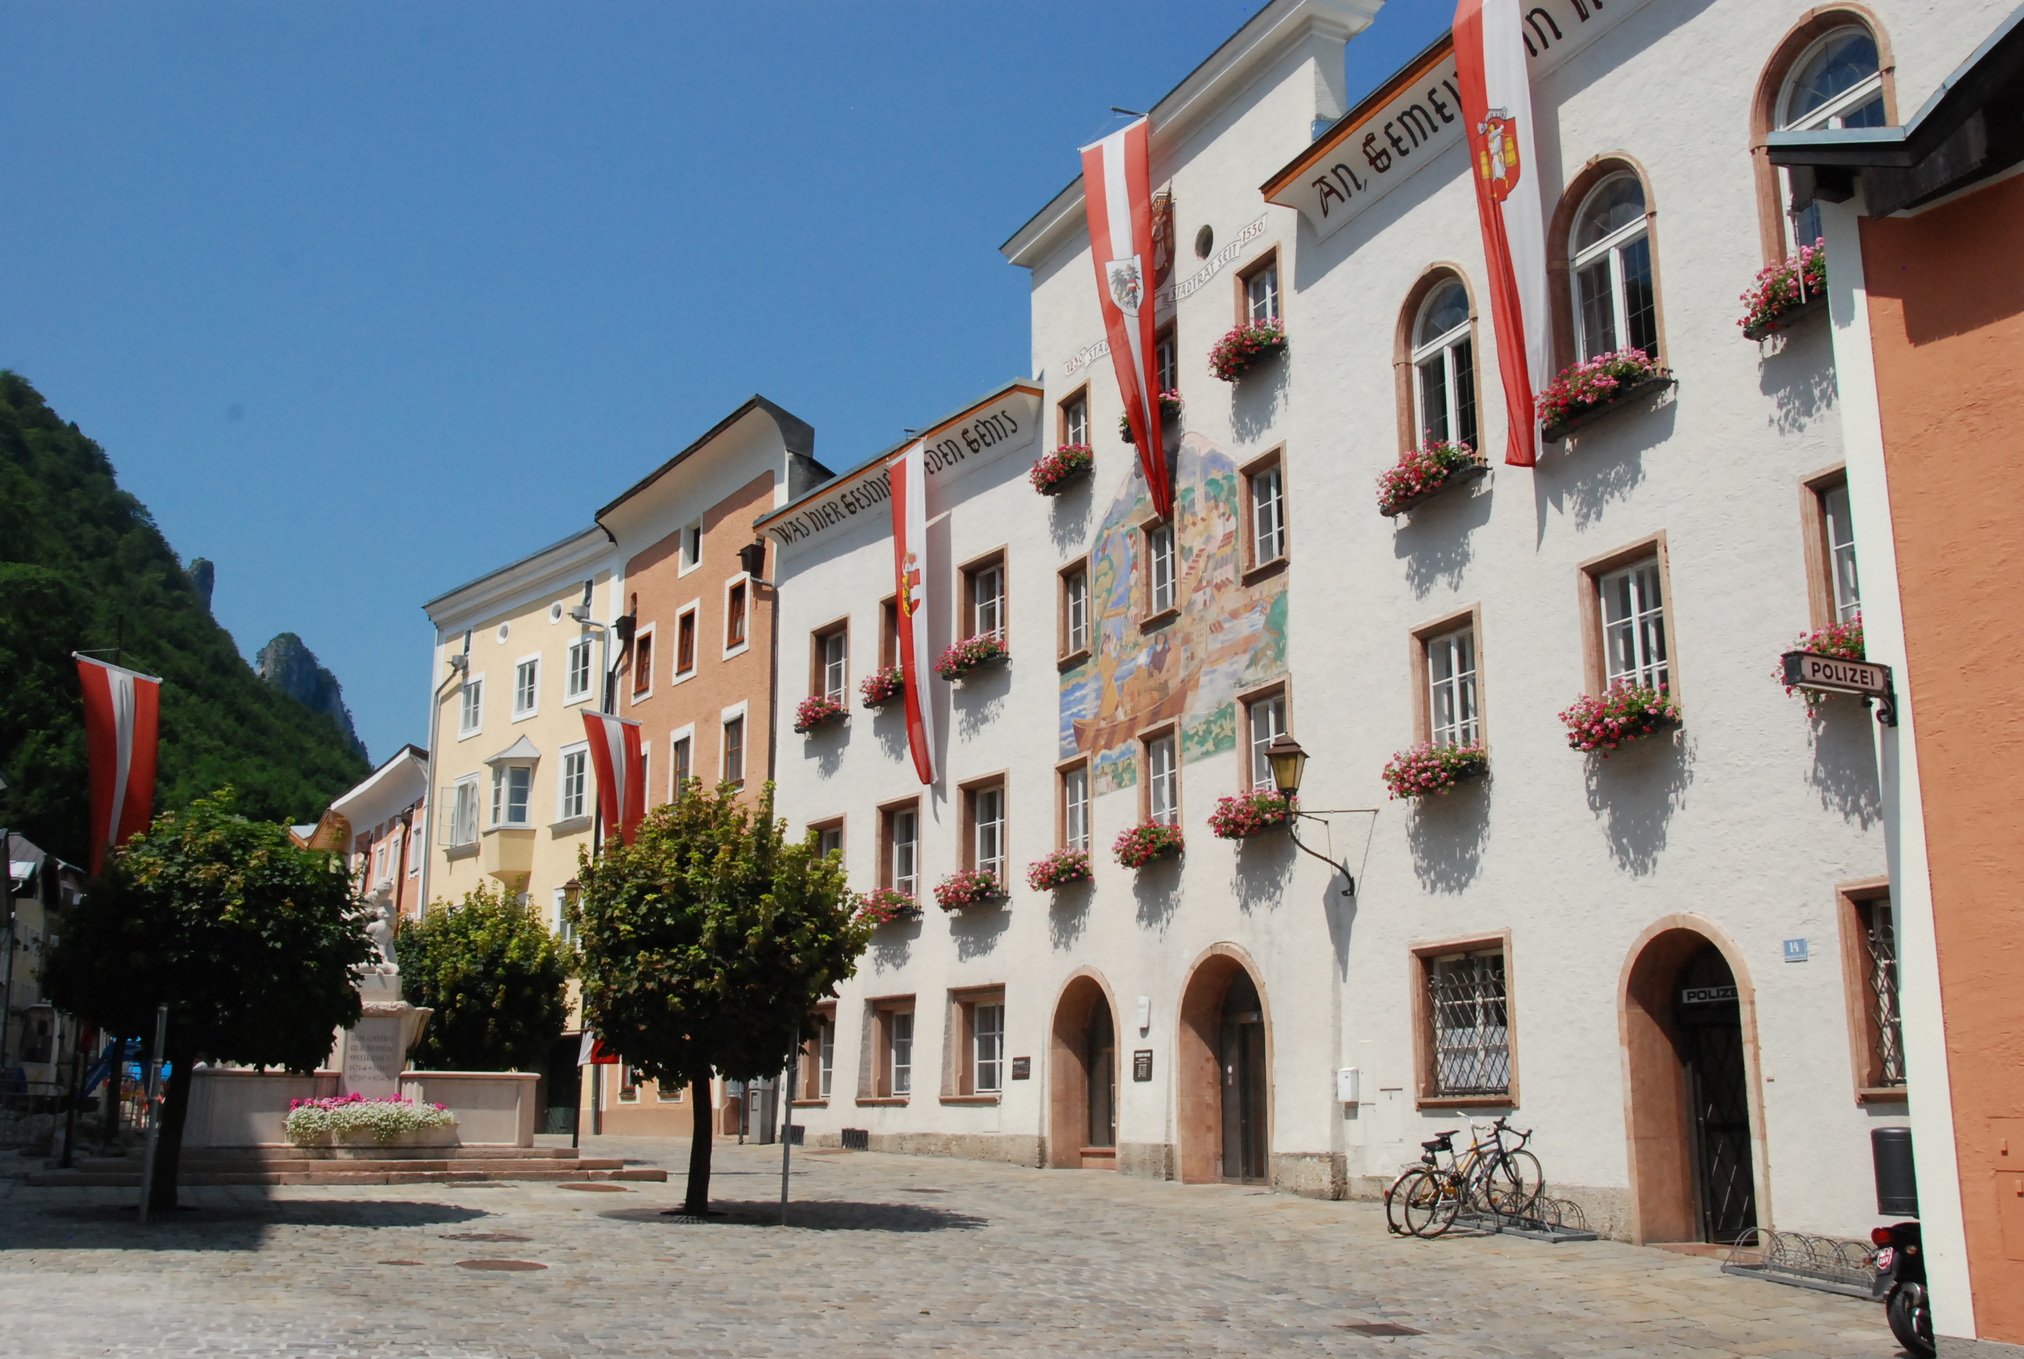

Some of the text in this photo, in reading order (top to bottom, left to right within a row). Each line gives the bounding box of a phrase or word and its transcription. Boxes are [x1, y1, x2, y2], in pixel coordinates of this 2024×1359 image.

[1171, 262, 1216, 300] STADTRAT
[1217, 243, 1238, 268] SEIT
[769, 516, 811, 547] WAS
[1811, 661, 1875, 687] POLIZEI
[1687, 987, 1739, 1002] POLIZE
